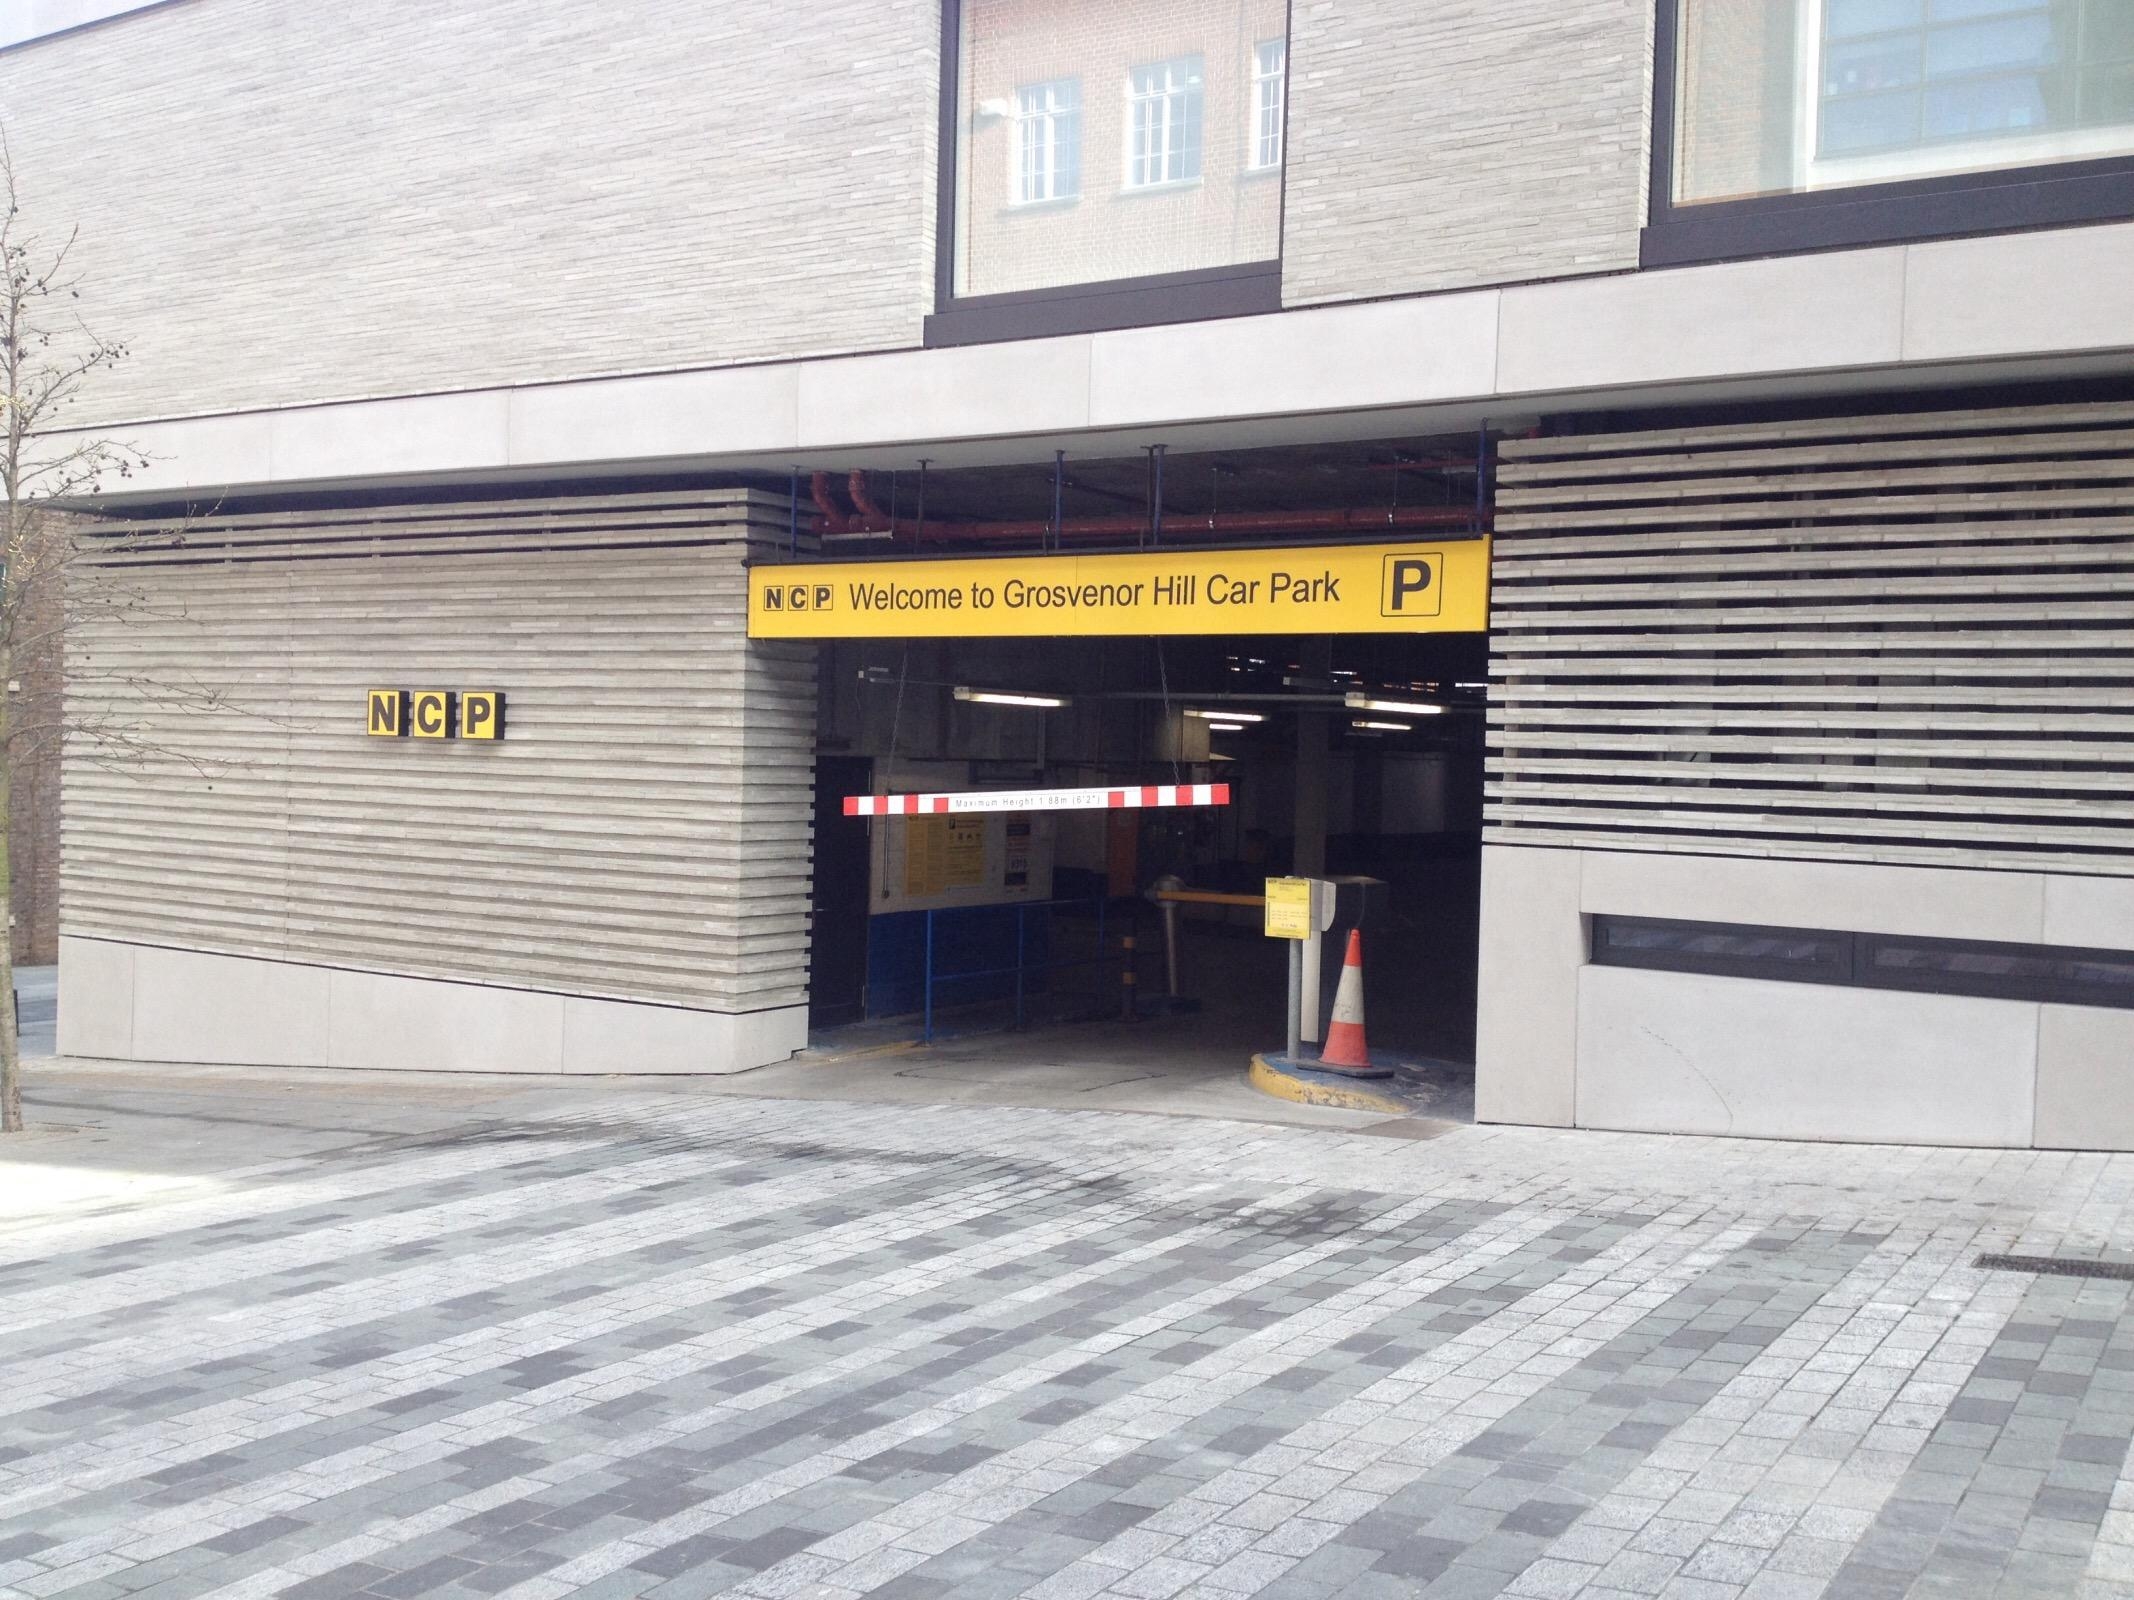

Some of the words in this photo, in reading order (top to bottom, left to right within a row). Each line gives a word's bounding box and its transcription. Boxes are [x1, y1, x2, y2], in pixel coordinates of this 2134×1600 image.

[765, 586, 831, 610] NCP
[849, 582, 963, 611] Welcome
[971, 582, 995, 609] to
[1003, 579, 1144, 609] Grosvenor
[1153, 575, 1196, 606] Hill
[1206, 573, 1260, 605] Car
[1270, 570, 1341, 603] Park
[1391, 559, 1432, 611] P
[371, 694, 491, 735] NCP
[955, 799, 998, 808] Maximum
[1002, 796, 1034, 807] Height
[1039, 796, 1068, 805] 188m
